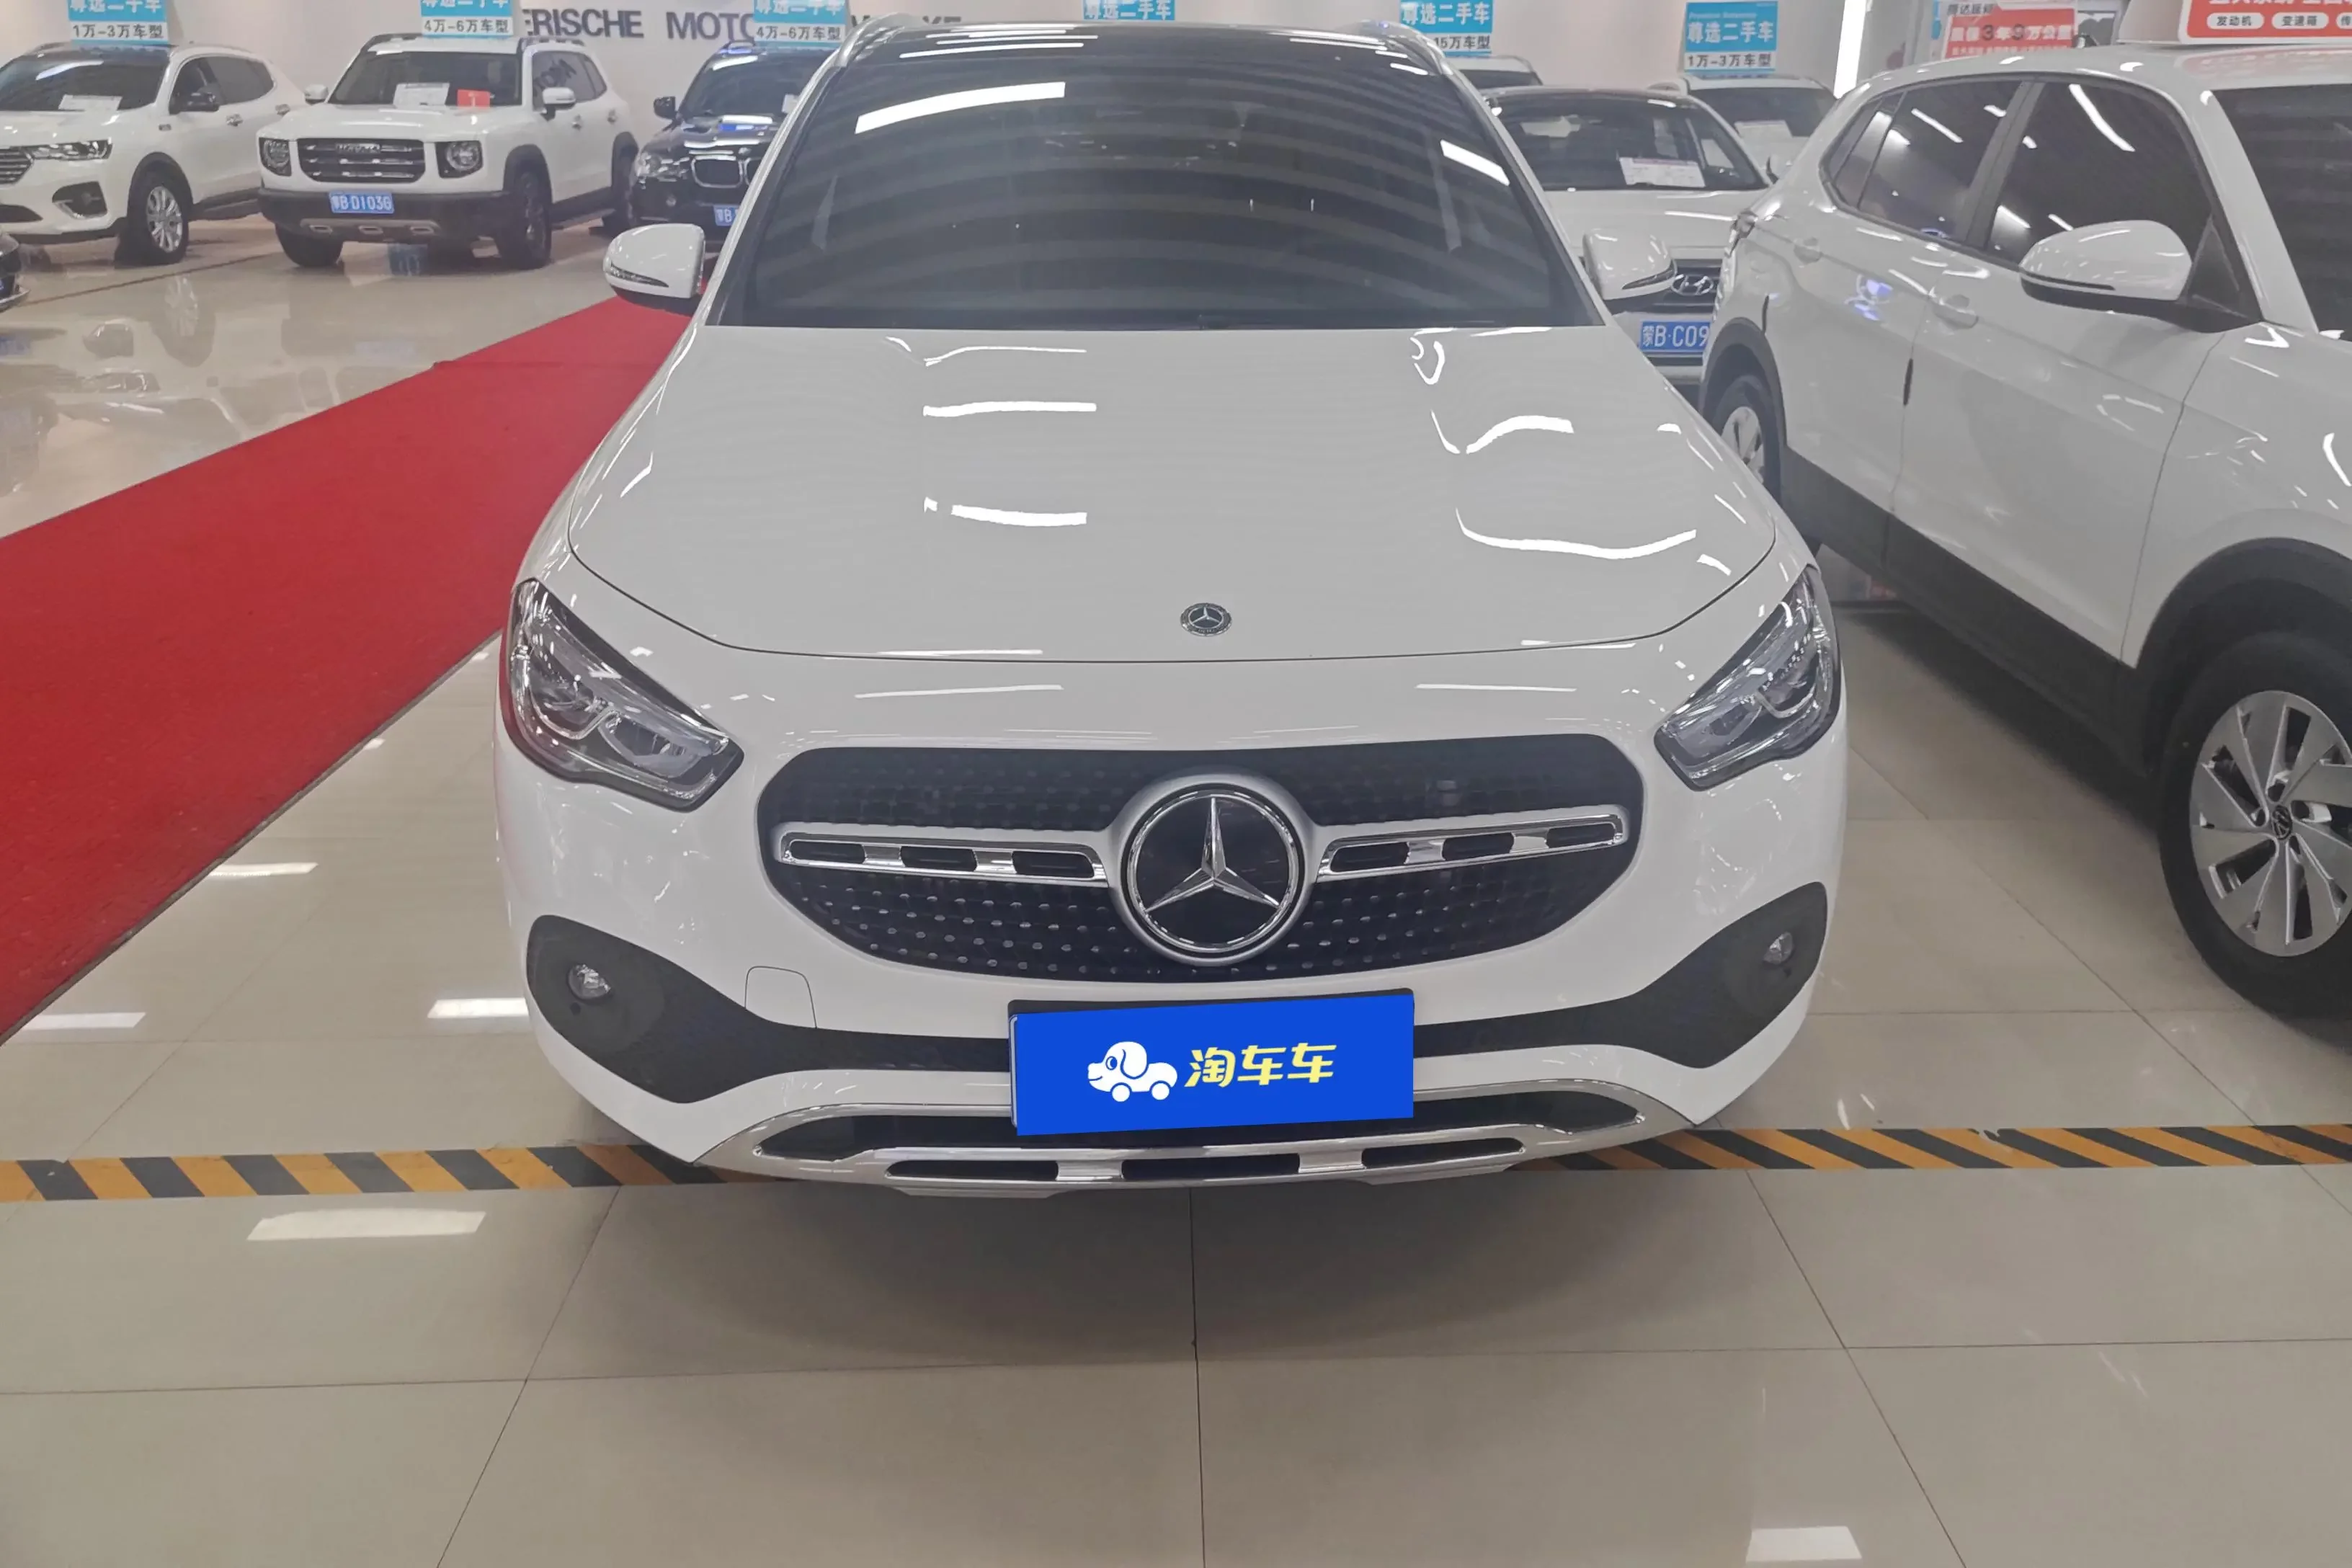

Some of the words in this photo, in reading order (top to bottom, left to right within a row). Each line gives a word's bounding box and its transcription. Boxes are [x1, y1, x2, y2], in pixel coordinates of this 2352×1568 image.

[73, 24, 164, 39] 1万-3万车型
[756, 26, 842, 40] 4万-6万车型
[1688, 54, 1771, 67] 1万-3万车型
